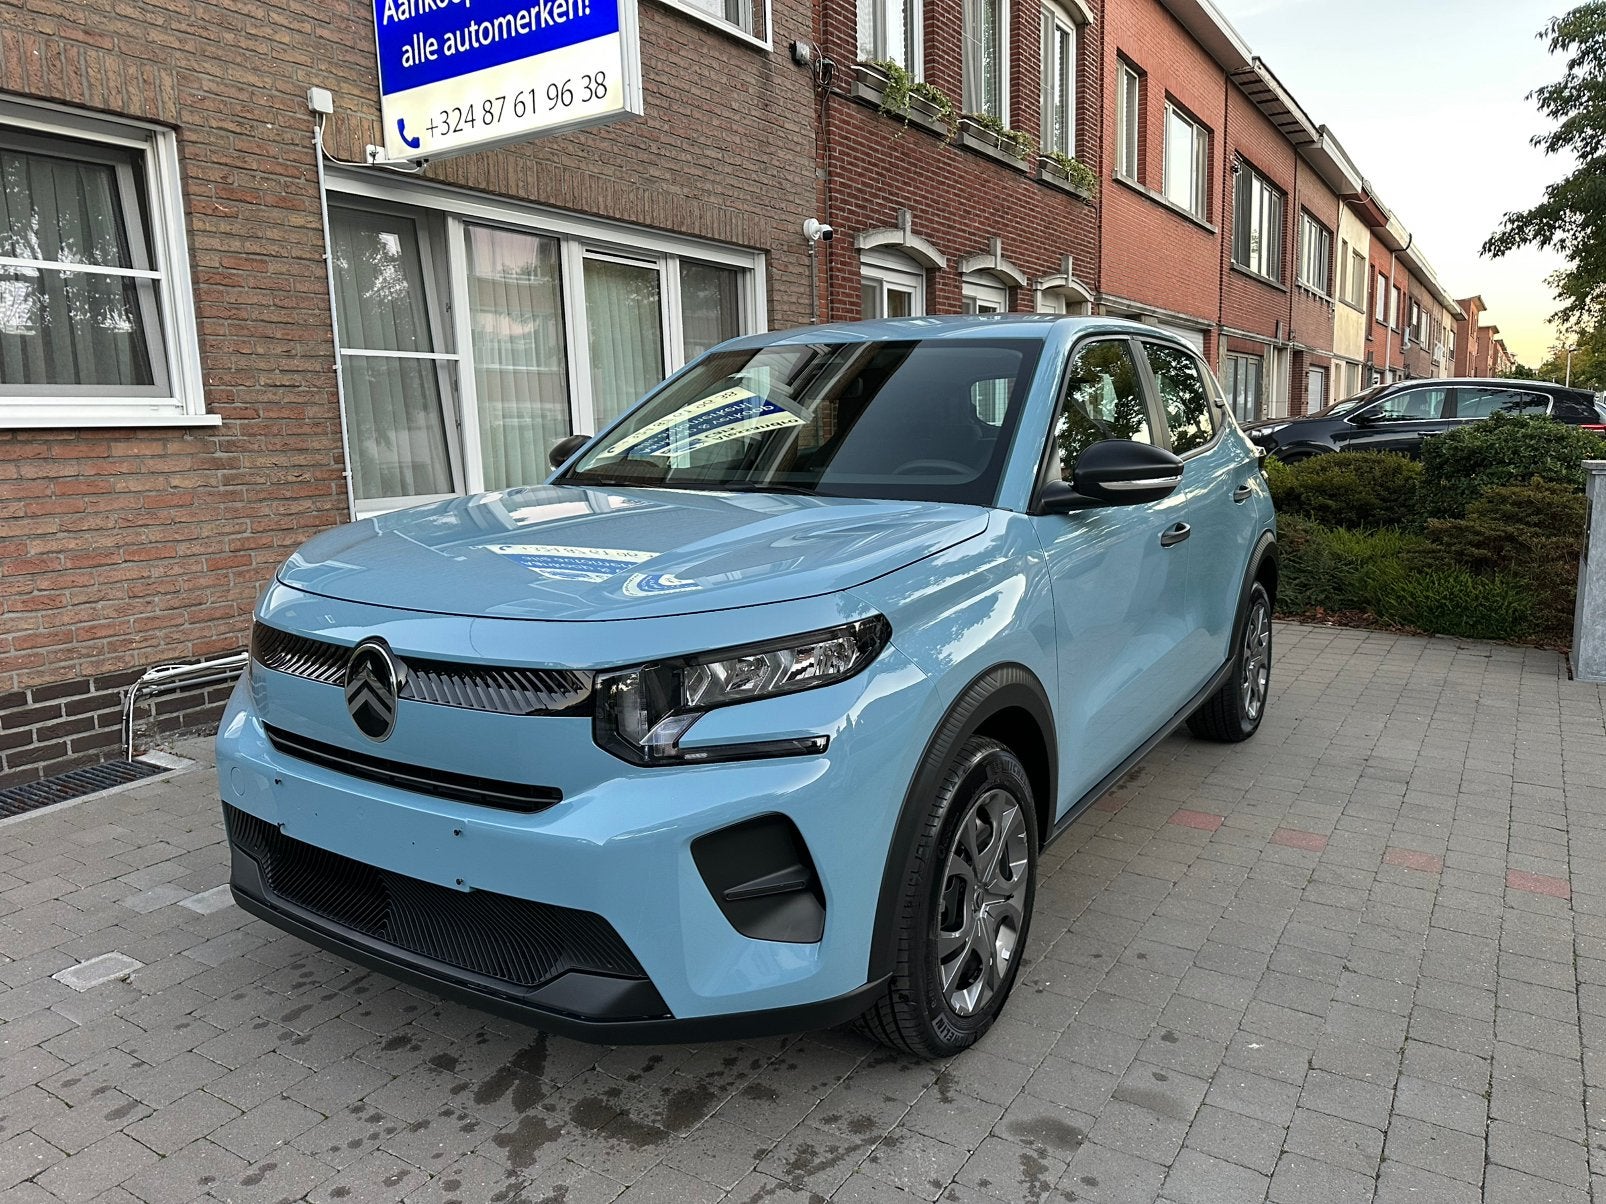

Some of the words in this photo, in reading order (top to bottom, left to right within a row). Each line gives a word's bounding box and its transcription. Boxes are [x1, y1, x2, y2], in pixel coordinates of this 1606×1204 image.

[402, 32, 438, 67] alle
[425, 104, 476, 138] +324
[482, 96, 506, 126] 87
[513, 88, 537, 118] 61
[547, 79, 574, 111] 96
[581, 71, 608, 102] 38
